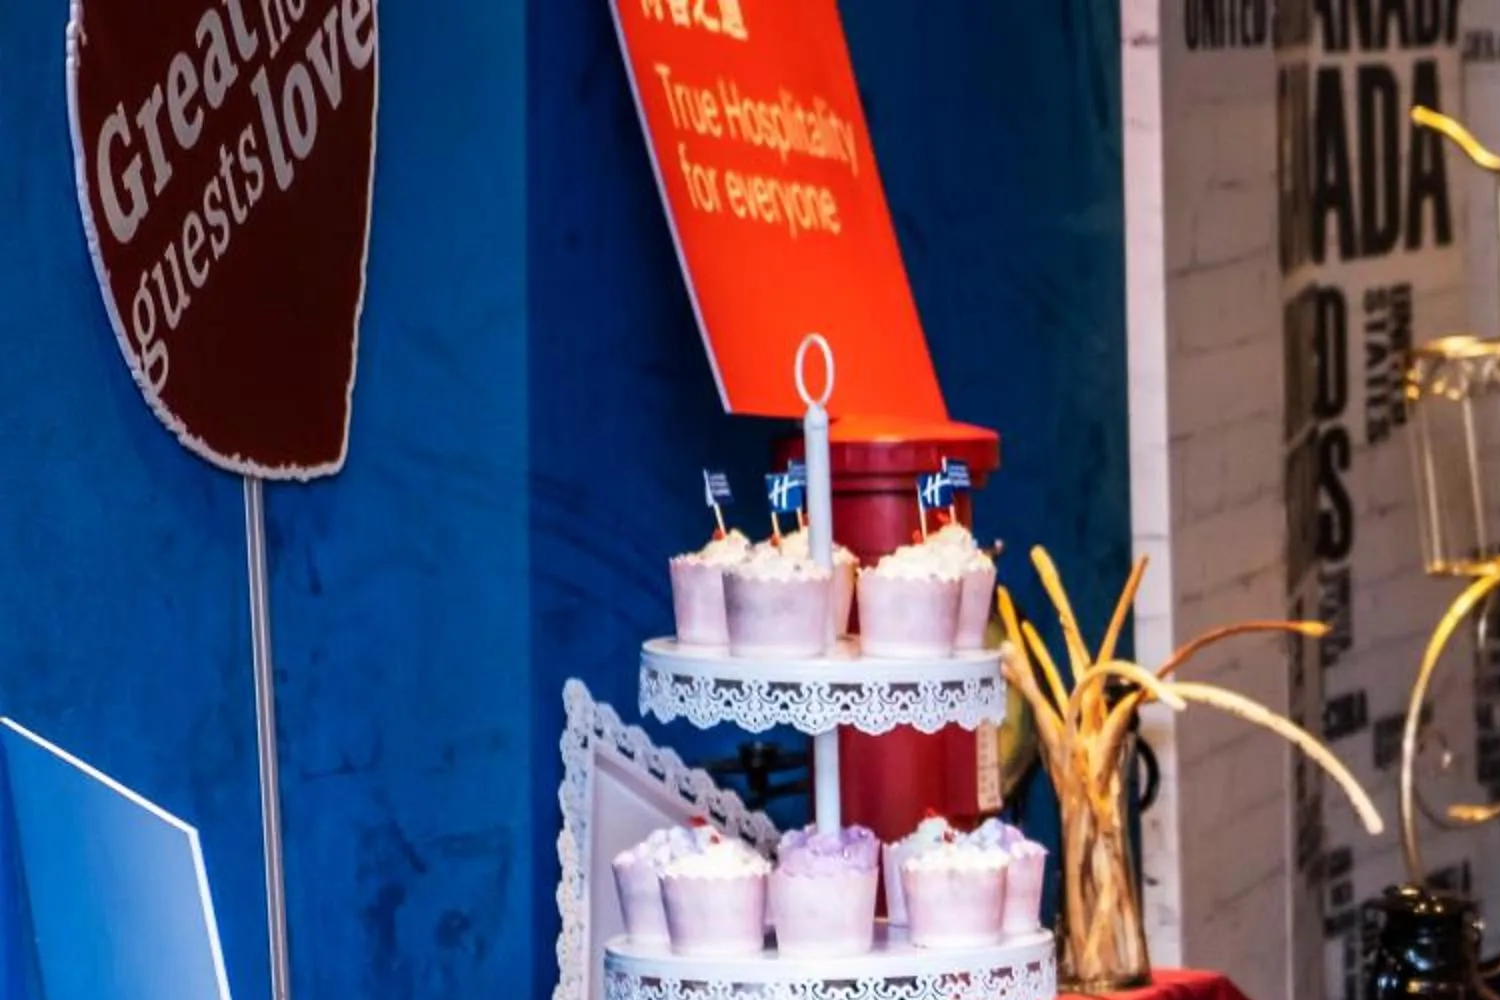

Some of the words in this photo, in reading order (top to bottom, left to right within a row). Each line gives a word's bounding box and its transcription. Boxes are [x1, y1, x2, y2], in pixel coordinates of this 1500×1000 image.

[655, 63, 723, 138] True
[717, 73, 859, 177] Hospitality
[132, 124, 265, 395] guests
[250, 0, 373, 191] love
[677, 141, 723, 213] for
[725, 168, 841, 238] everyone
